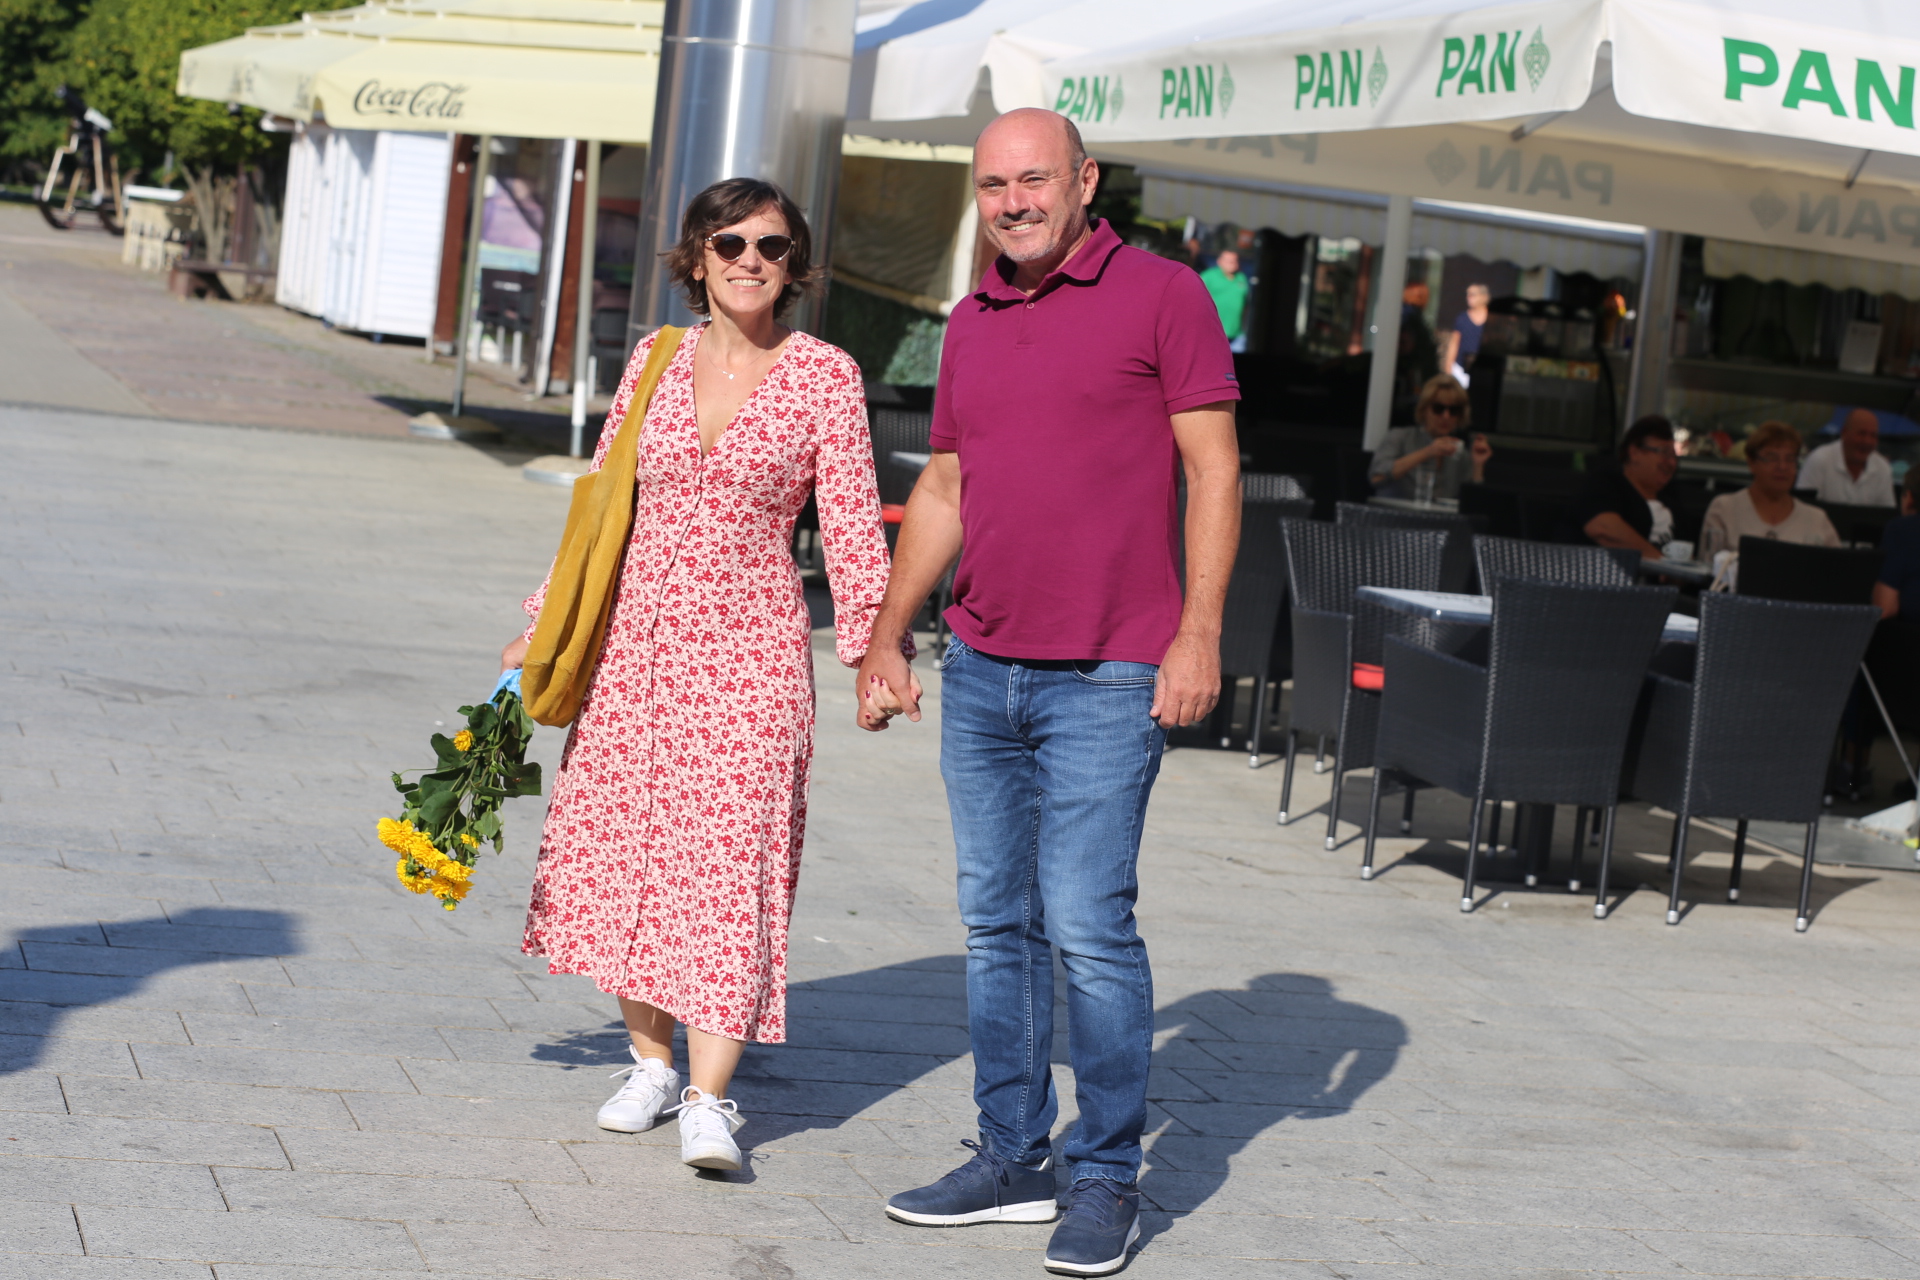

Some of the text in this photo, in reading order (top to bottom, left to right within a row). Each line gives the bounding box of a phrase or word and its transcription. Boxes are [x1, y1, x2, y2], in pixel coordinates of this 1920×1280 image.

[1159, 64, 1214, 120] PAN
[1295, 49, 1363, 110] PAN
[1436, 29, 1522, 98] PAN
[1722, 36, 1917, 130] PAN
[354, 78, 471, 118] Coca-Cola
[1055, 76, 1109, 122] PAN
